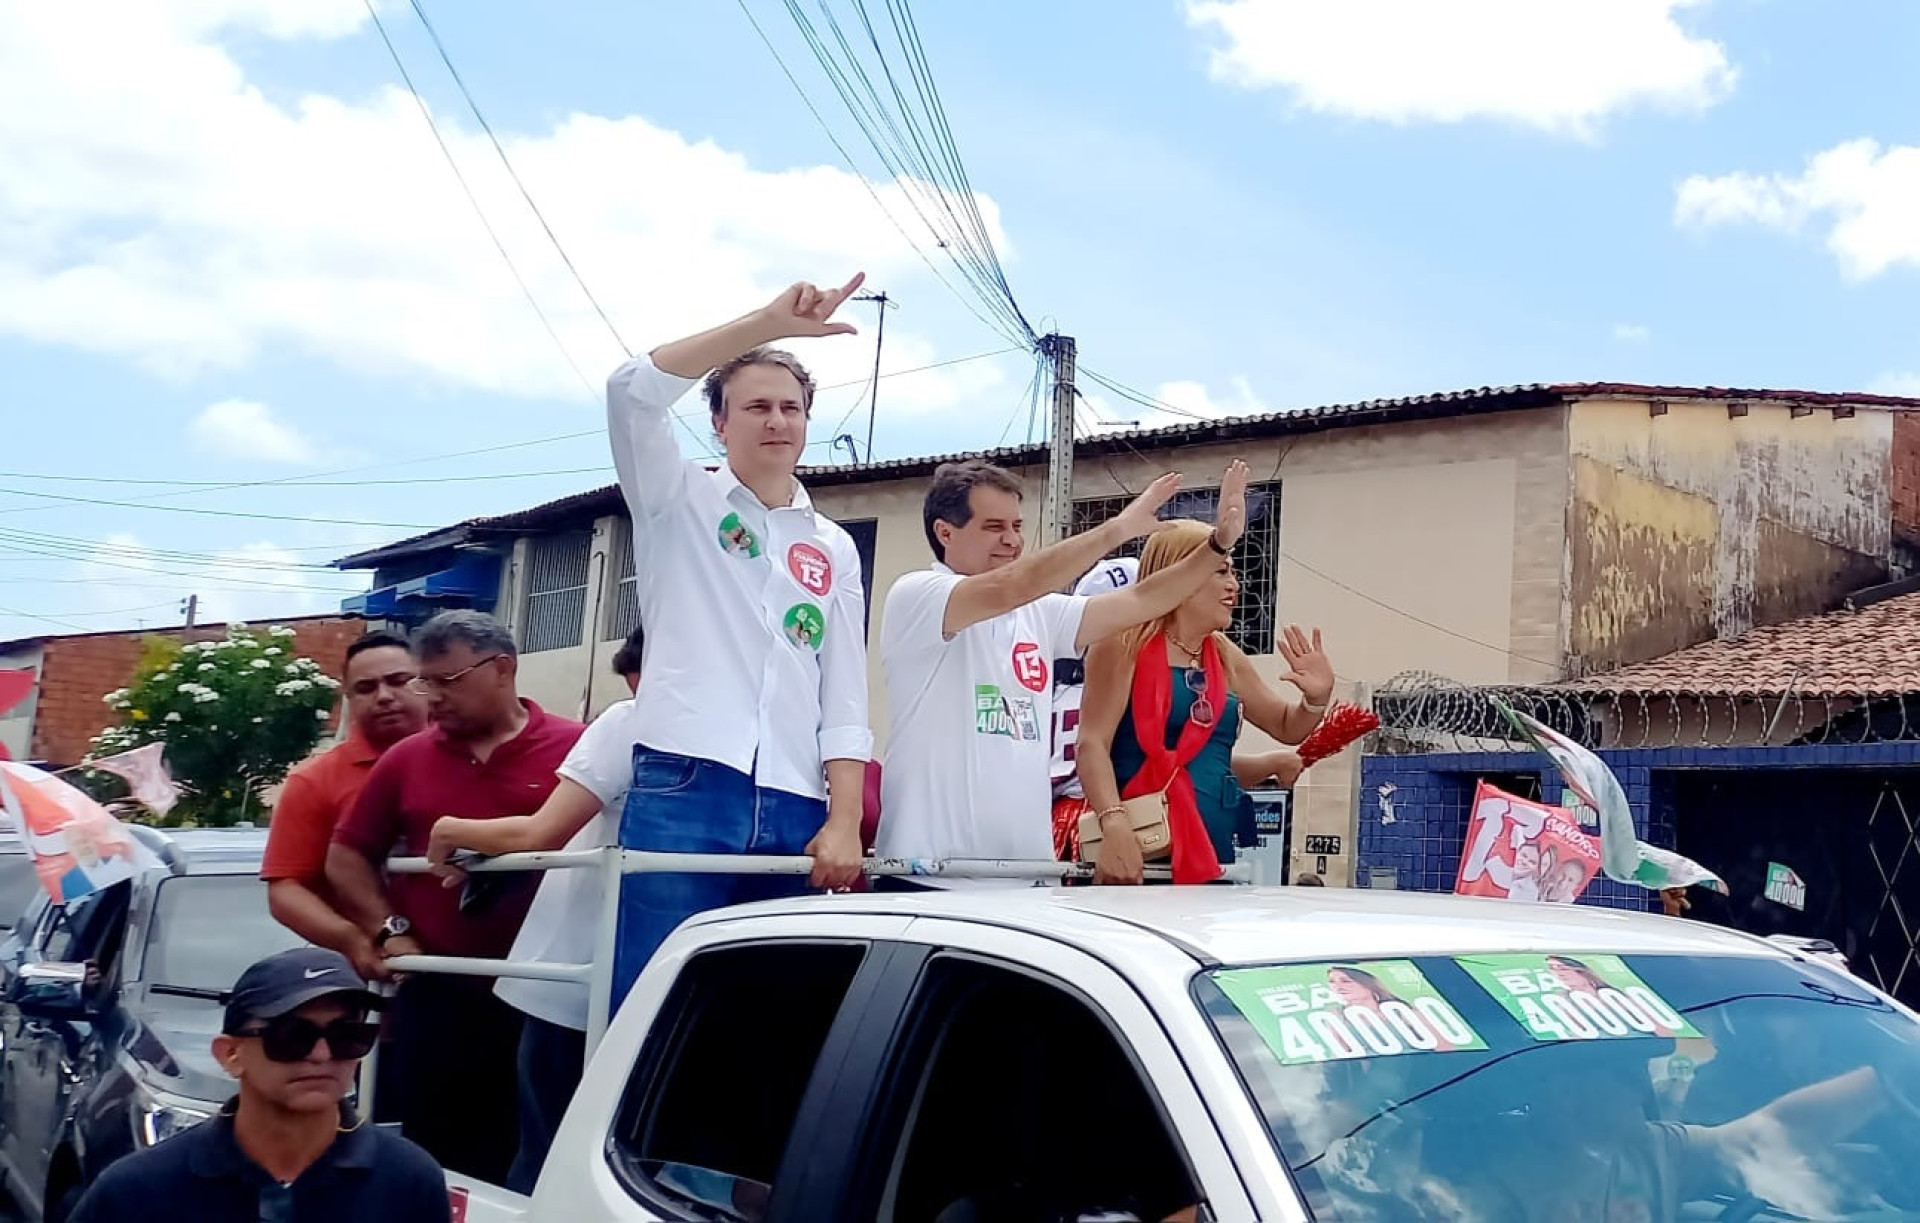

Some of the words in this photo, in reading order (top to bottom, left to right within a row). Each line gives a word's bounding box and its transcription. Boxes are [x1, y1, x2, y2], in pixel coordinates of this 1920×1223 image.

[800, 563, 824, 588] 13
[1105, 566, 1129, 588] 13
[1014, 650, 1041, 681] 13
[1279, 997, 1473, 1060] 40000
[1517, 986, 1683, 1040] 40000
